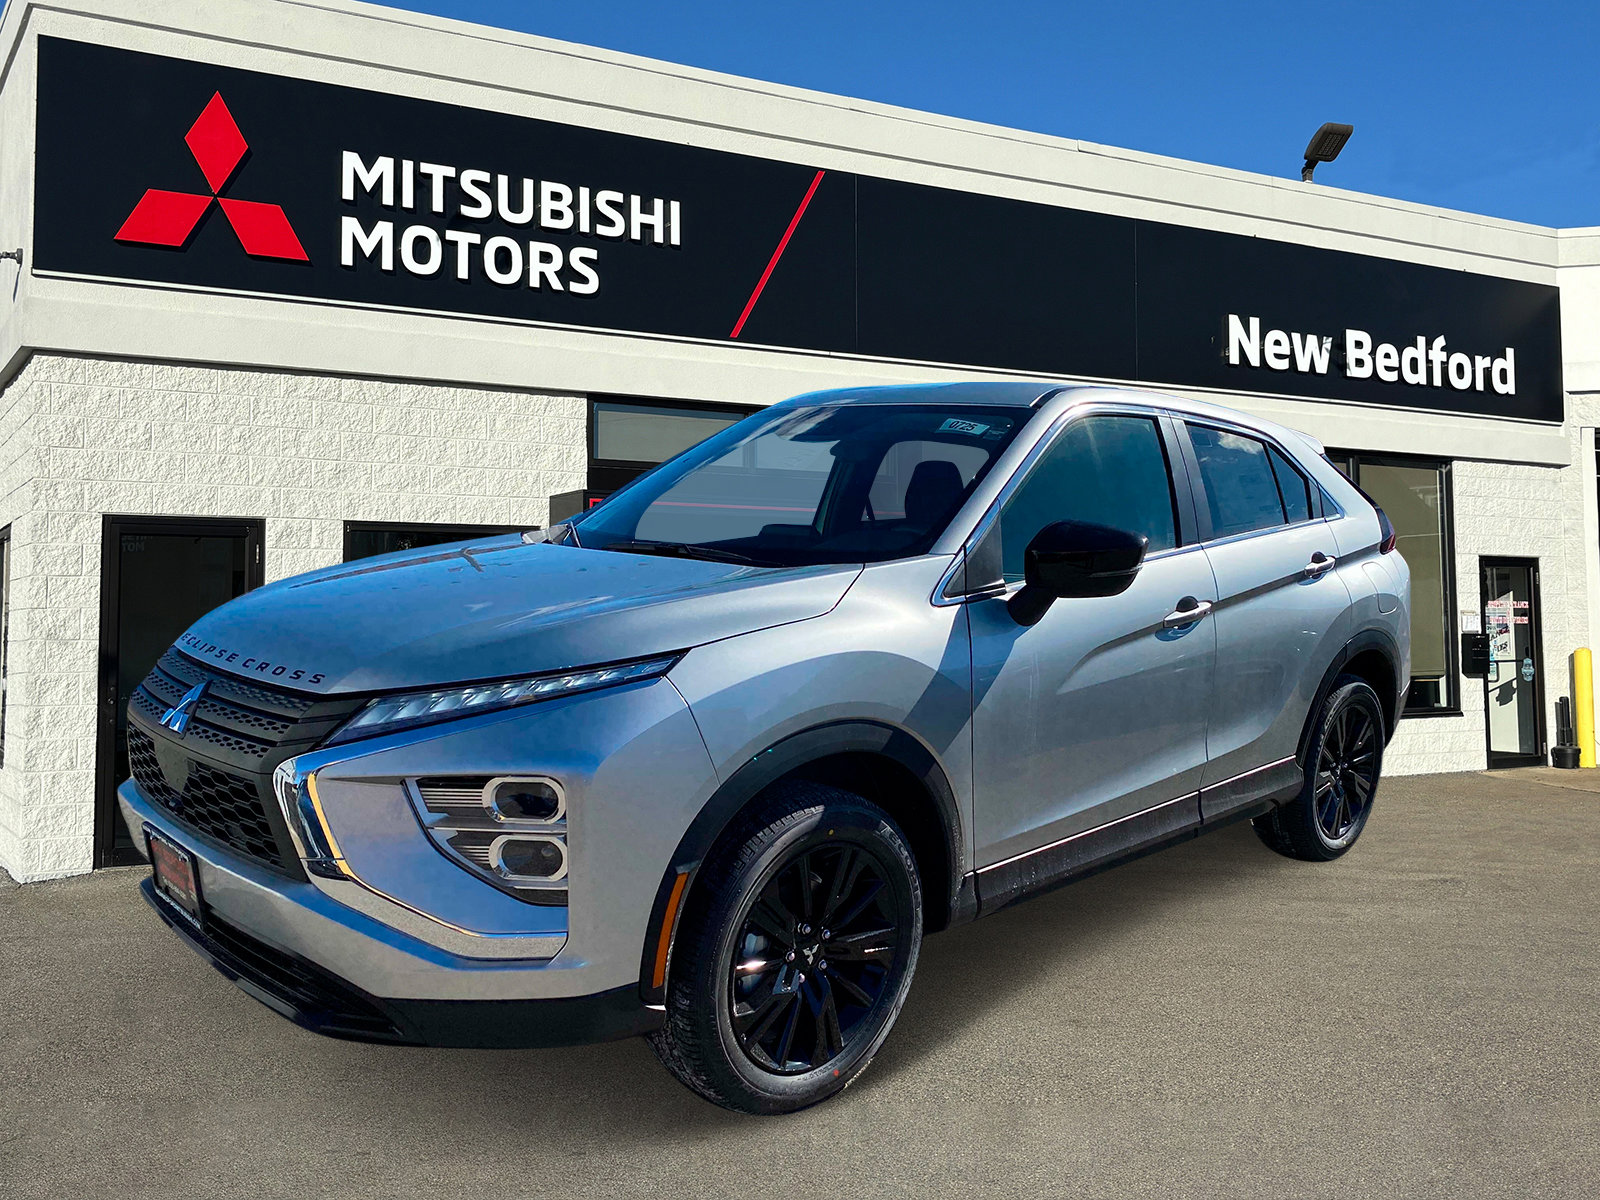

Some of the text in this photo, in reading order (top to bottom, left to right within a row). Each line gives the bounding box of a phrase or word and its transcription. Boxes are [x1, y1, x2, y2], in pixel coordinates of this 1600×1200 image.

[341, 150, 681, 246] MITSUBISHI
[340, 215, 600, 295] MOTORS
[1228, 313, 1516, 395] New Bedford
[948, 420, 978, 432] 0725
[180, 632, 326, 685] ECLIPSE CROSS
